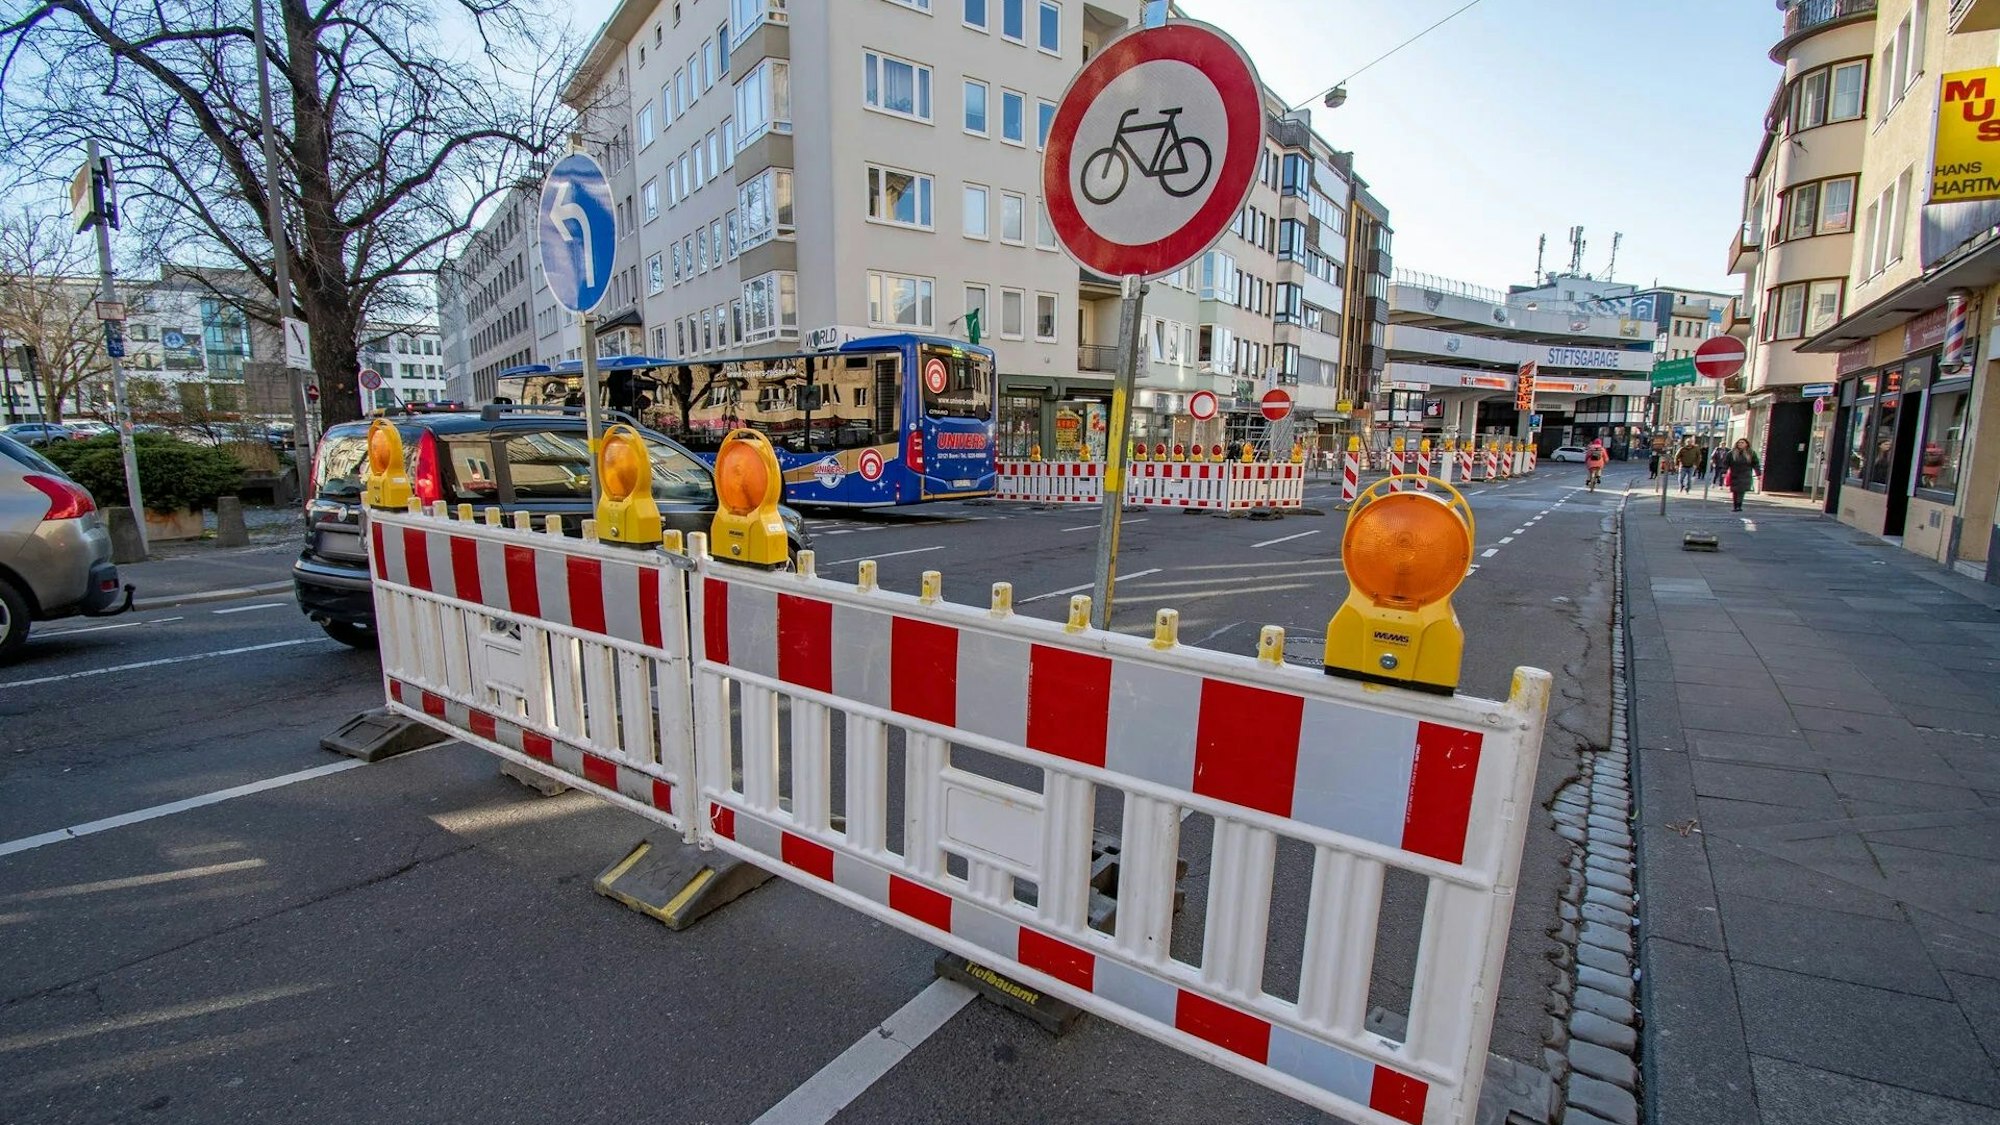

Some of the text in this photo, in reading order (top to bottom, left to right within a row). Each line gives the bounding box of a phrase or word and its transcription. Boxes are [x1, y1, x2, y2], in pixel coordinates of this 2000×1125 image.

[1935, 161, 1982, 176] HANS
[1548, 347, 1619, 368] STIFTSGARAGE
[937, 432, 986, 449] UNIVERS
[1373, 631, 1409, 644] WEMAS
[965, 960, 1039, 1006] Tiefbauamt
